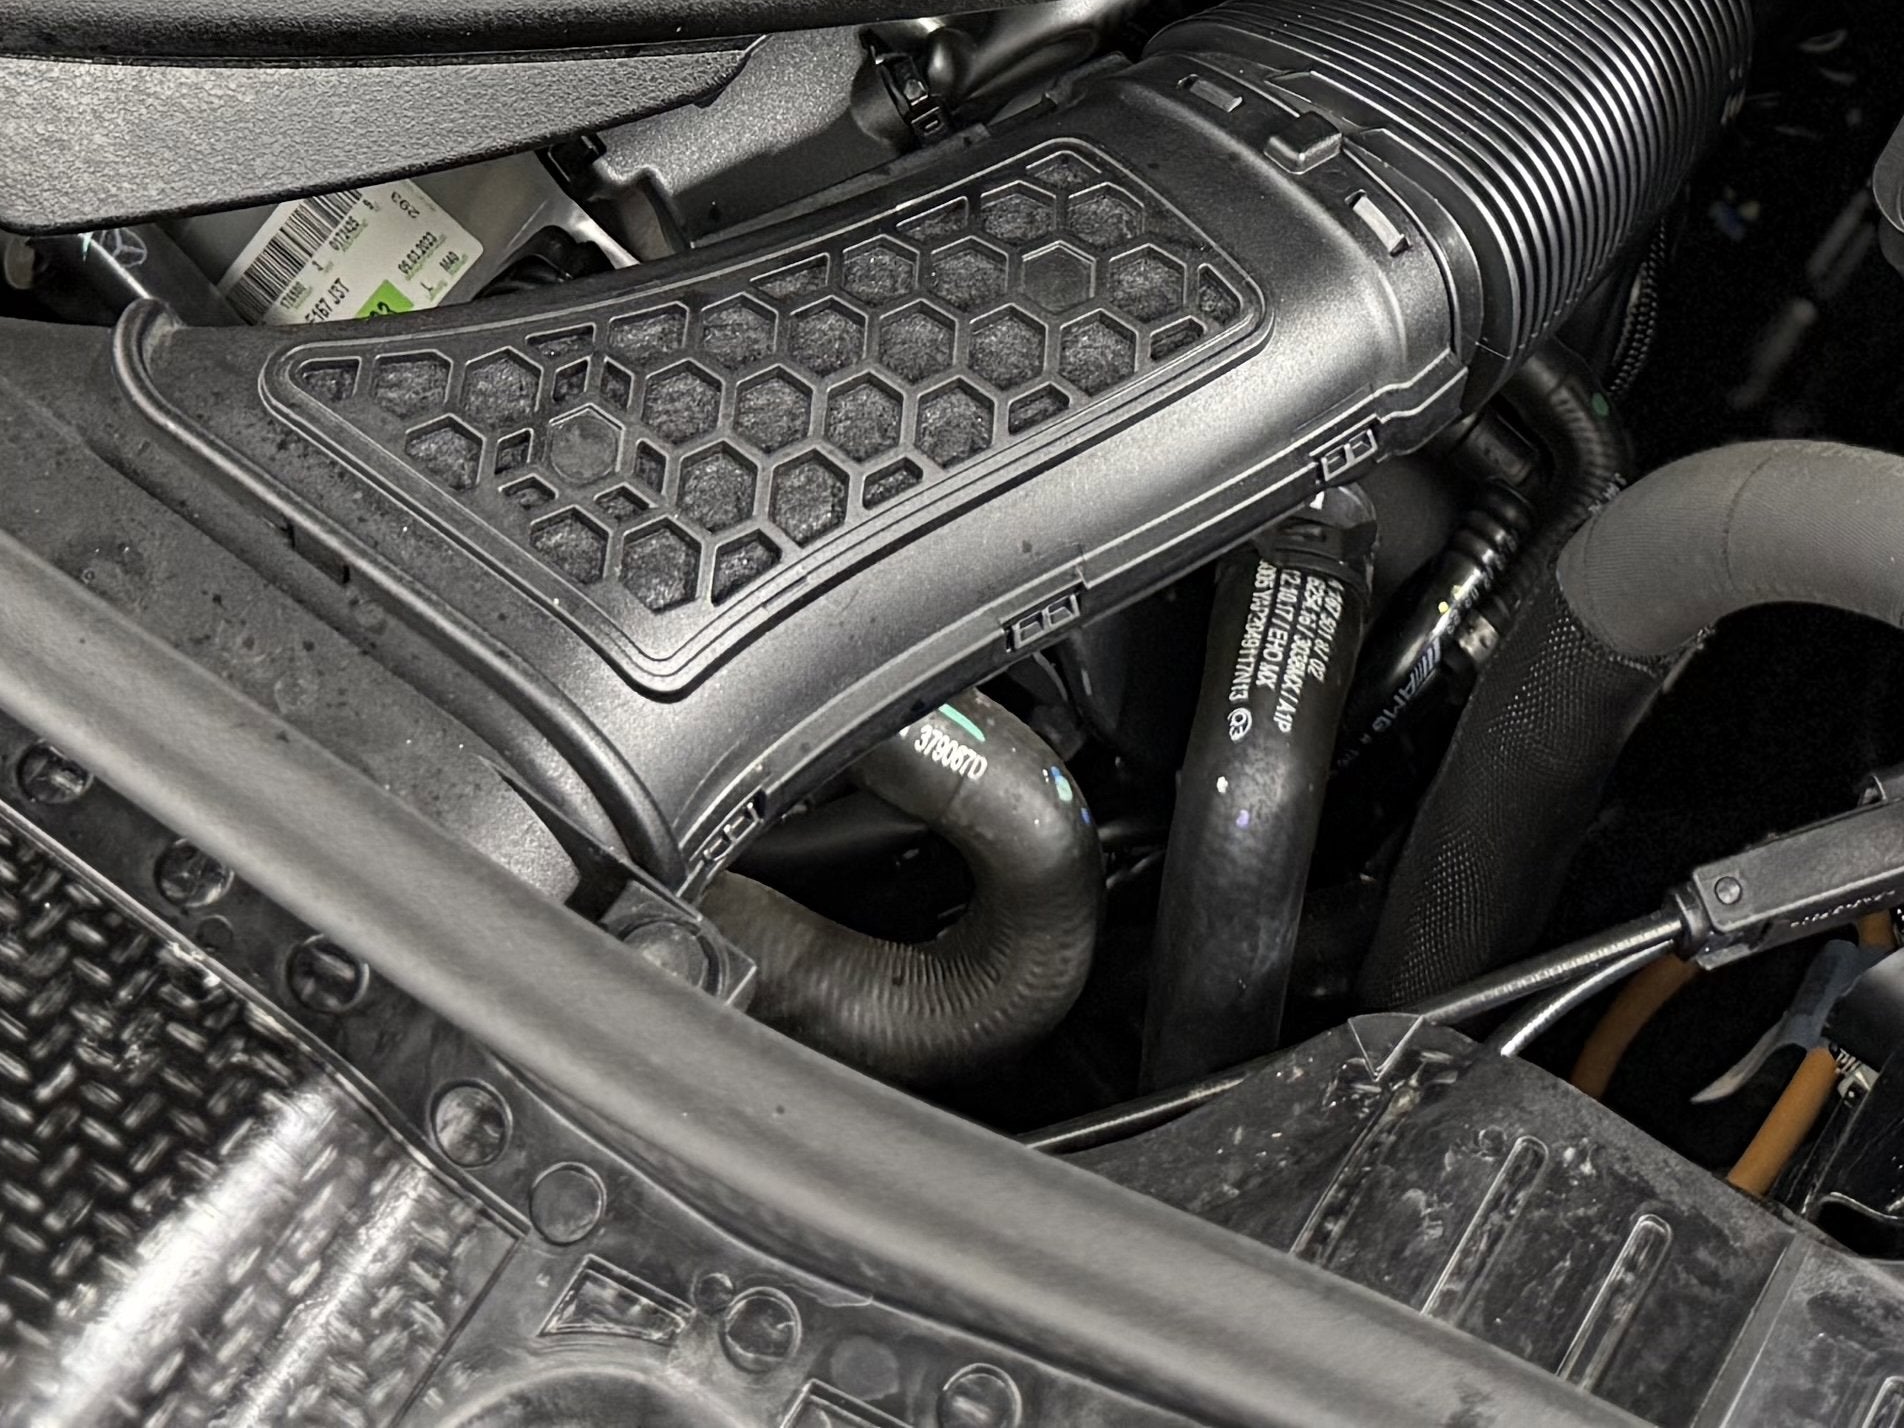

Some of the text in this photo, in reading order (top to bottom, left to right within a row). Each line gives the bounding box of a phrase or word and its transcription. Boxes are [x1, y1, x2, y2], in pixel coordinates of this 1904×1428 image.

[391, 191, 421, 219] 293
[328, 278, 350, 305] J3T
[1307, 659, 1327, 682] 02
[1273, 699, 1296, 733] A1P
[1373, 681, 1419, 730] AMG
